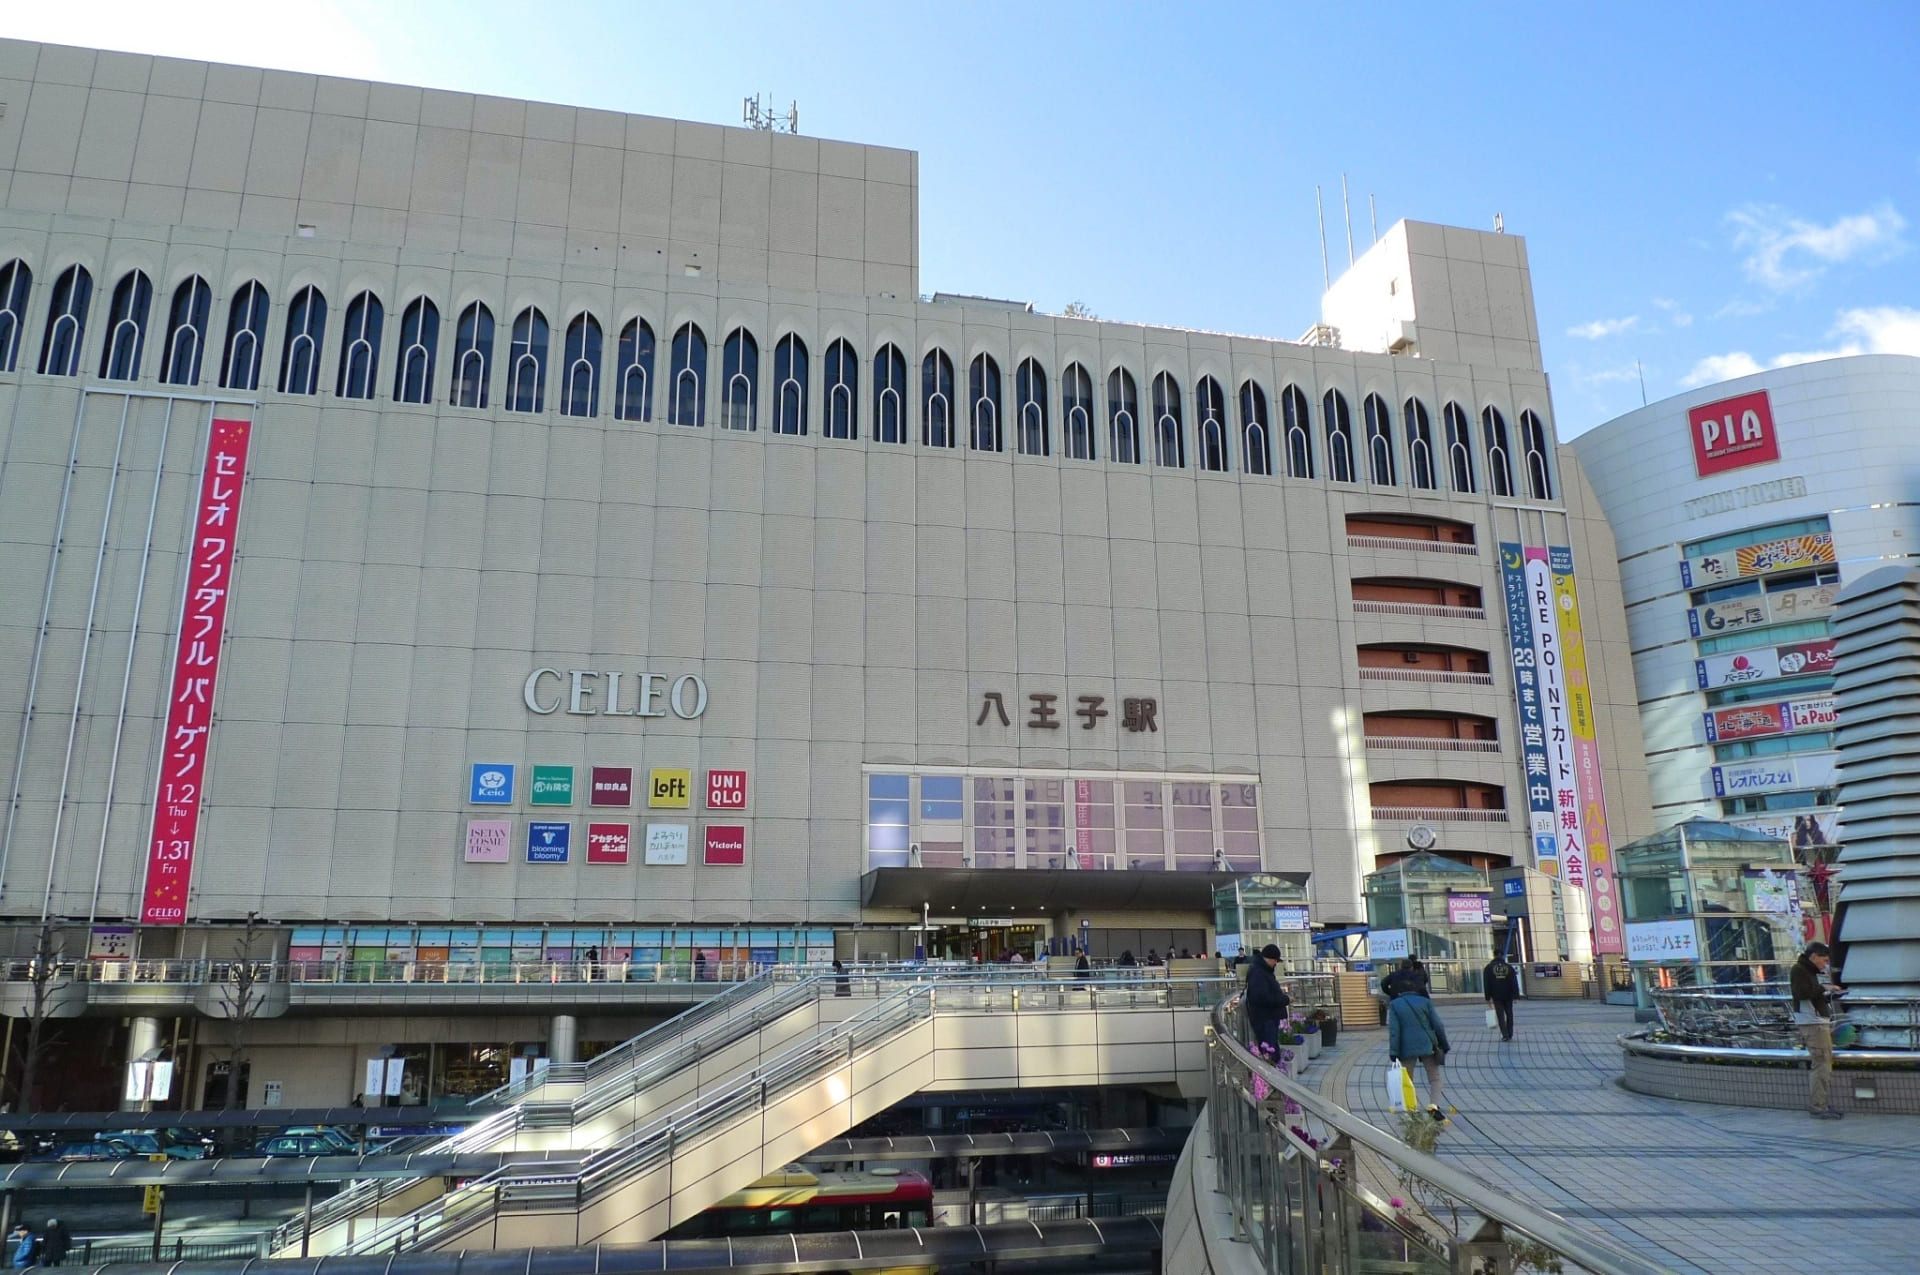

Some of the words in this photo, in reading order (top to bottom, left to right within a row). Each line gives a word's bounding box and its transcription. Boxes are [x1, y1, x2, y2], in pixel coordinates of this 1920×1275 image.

[1701, 409, 1762, 451] PIA
[206, 450, 238, 527] セレオ
[1685, 489, 1737, 521] TWIN
[1736, 475, 1809, 509] TOWER
[1815, 534, 1831, 545] 9F
[184, 537, 227, 667] ワンダフル
[1535, 572, 1550, 624] JRE
[1507, 574, 1521, 643] ドラッグストア
[1514, 574, 1531, 644] スーパーマーケット
[1723, 669, 1765, 683] バーミヤン
[523, 667, 709, 721] CELEO
[977, 691, 1158, 733] 八王子駅
[1541, 632, 1571, 781] POINTカード
[172, 677, 208, 779] バーゲン
[1513, 647, 1551, 806] 23時まで営業中
[595, 782, 628, 792] 無印良品
[712, 775, 740, 789] UNI
[166, 783, 194, 806] 1.2
[478, 788, 505, 798] Keio
[711, 790, 742, 805] QLO
[167, 805, 188, 818] Thu
[470, 828, 506, 838] ISETAN
[469, 836, 504, 847] COSME
[708, 840, 742, 850] Victoria
[156, 840, 190, 862] 1.31
[469, 845, 492, 855] TICS
[532, 846, 564, 856] blooming
[534, 852, 561, 862] bloomy
[162, 862, 178, 874] Fri
[147, 907, 181, 918] CELEO
[1661, 934, 1692, 950] 八王子
[369, 1126, 379, 1136] 4
